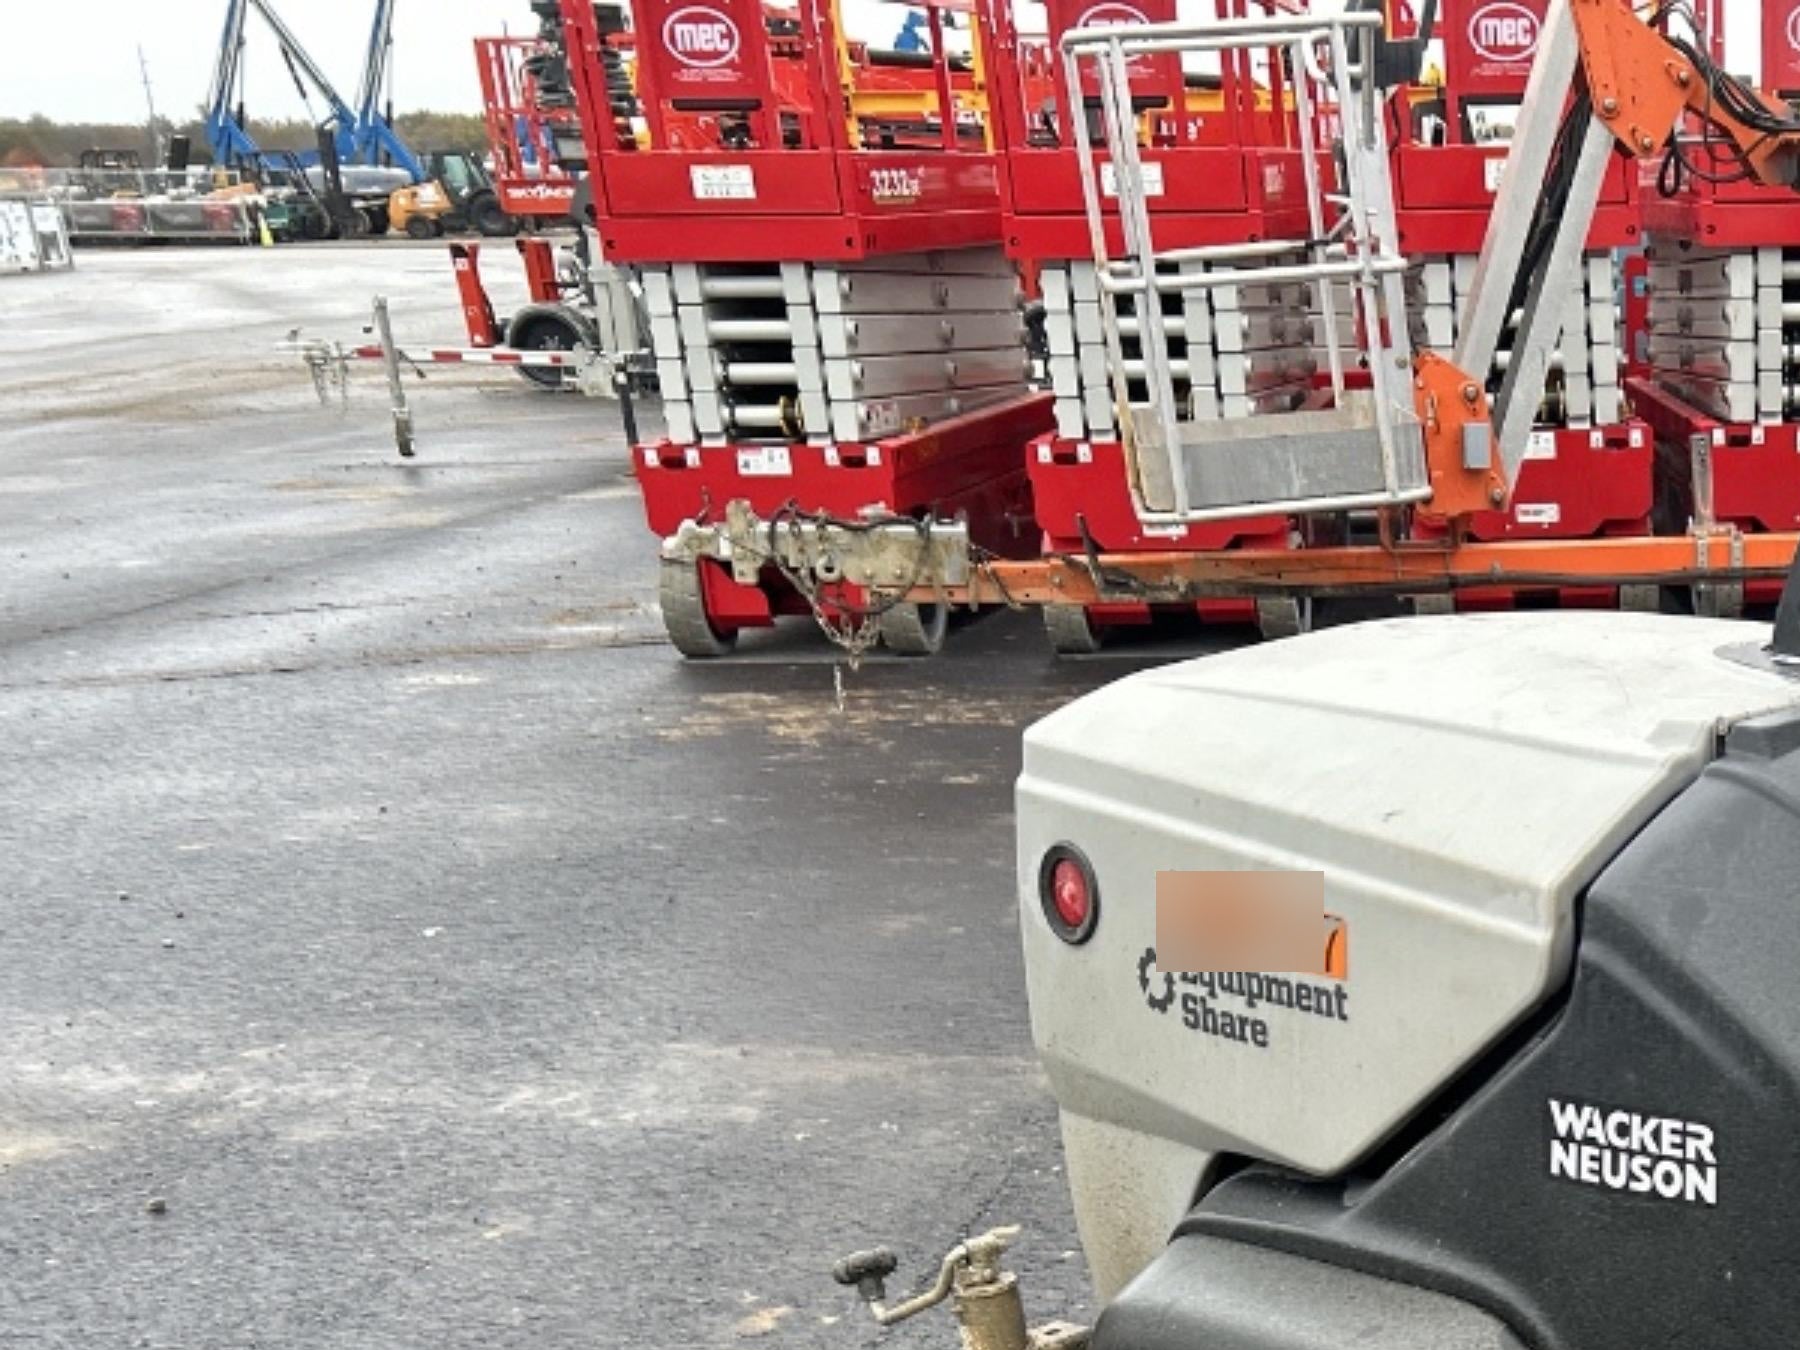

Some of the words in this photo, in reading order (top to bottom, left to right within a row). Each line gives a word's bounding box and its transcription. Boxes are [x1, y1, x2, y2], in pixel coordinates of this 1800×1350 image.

[1181, 992, 1269, 1047] Share
[1549, 1098, 1718, 1165] WACKER
[1550, 1139, 1718, 1205] NEUSON
